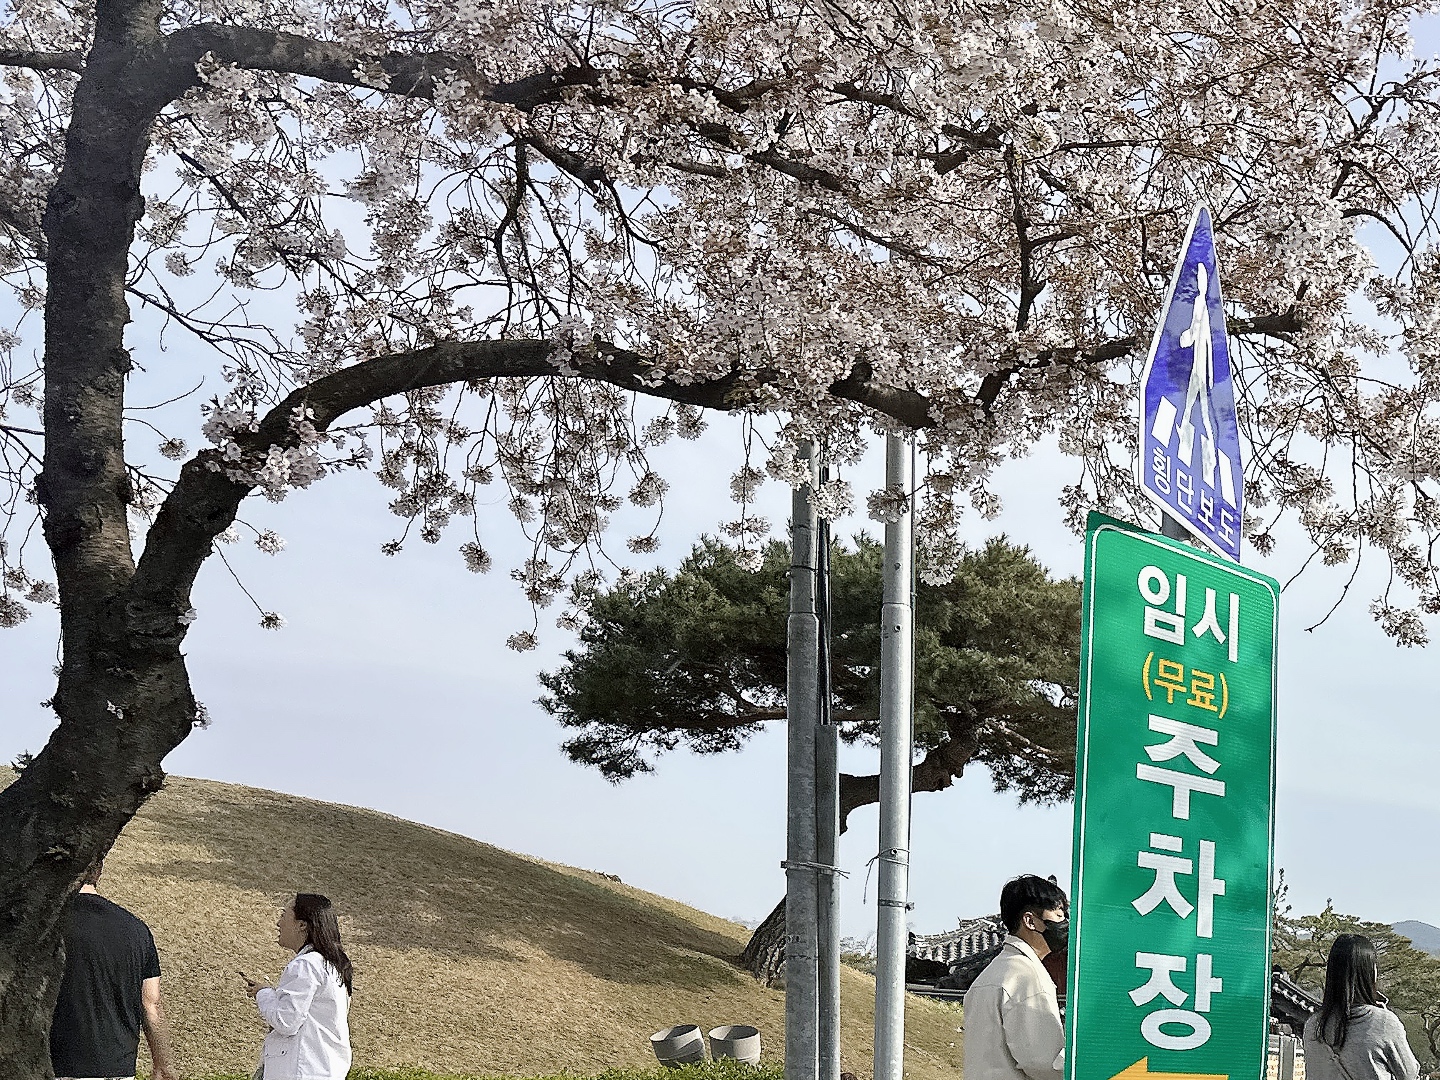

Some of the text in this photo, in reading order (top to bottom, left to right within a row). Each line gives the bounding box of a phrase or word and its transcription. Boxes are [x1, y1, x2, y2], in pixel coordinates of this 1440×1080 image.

[1152, 446, 1237, 548] 횡단보도
[1137, 564, 1241, 664] 임시
[1142, 650, 1229, 720] (무료)
[1128, 713, 1227, 1052] 주차장
